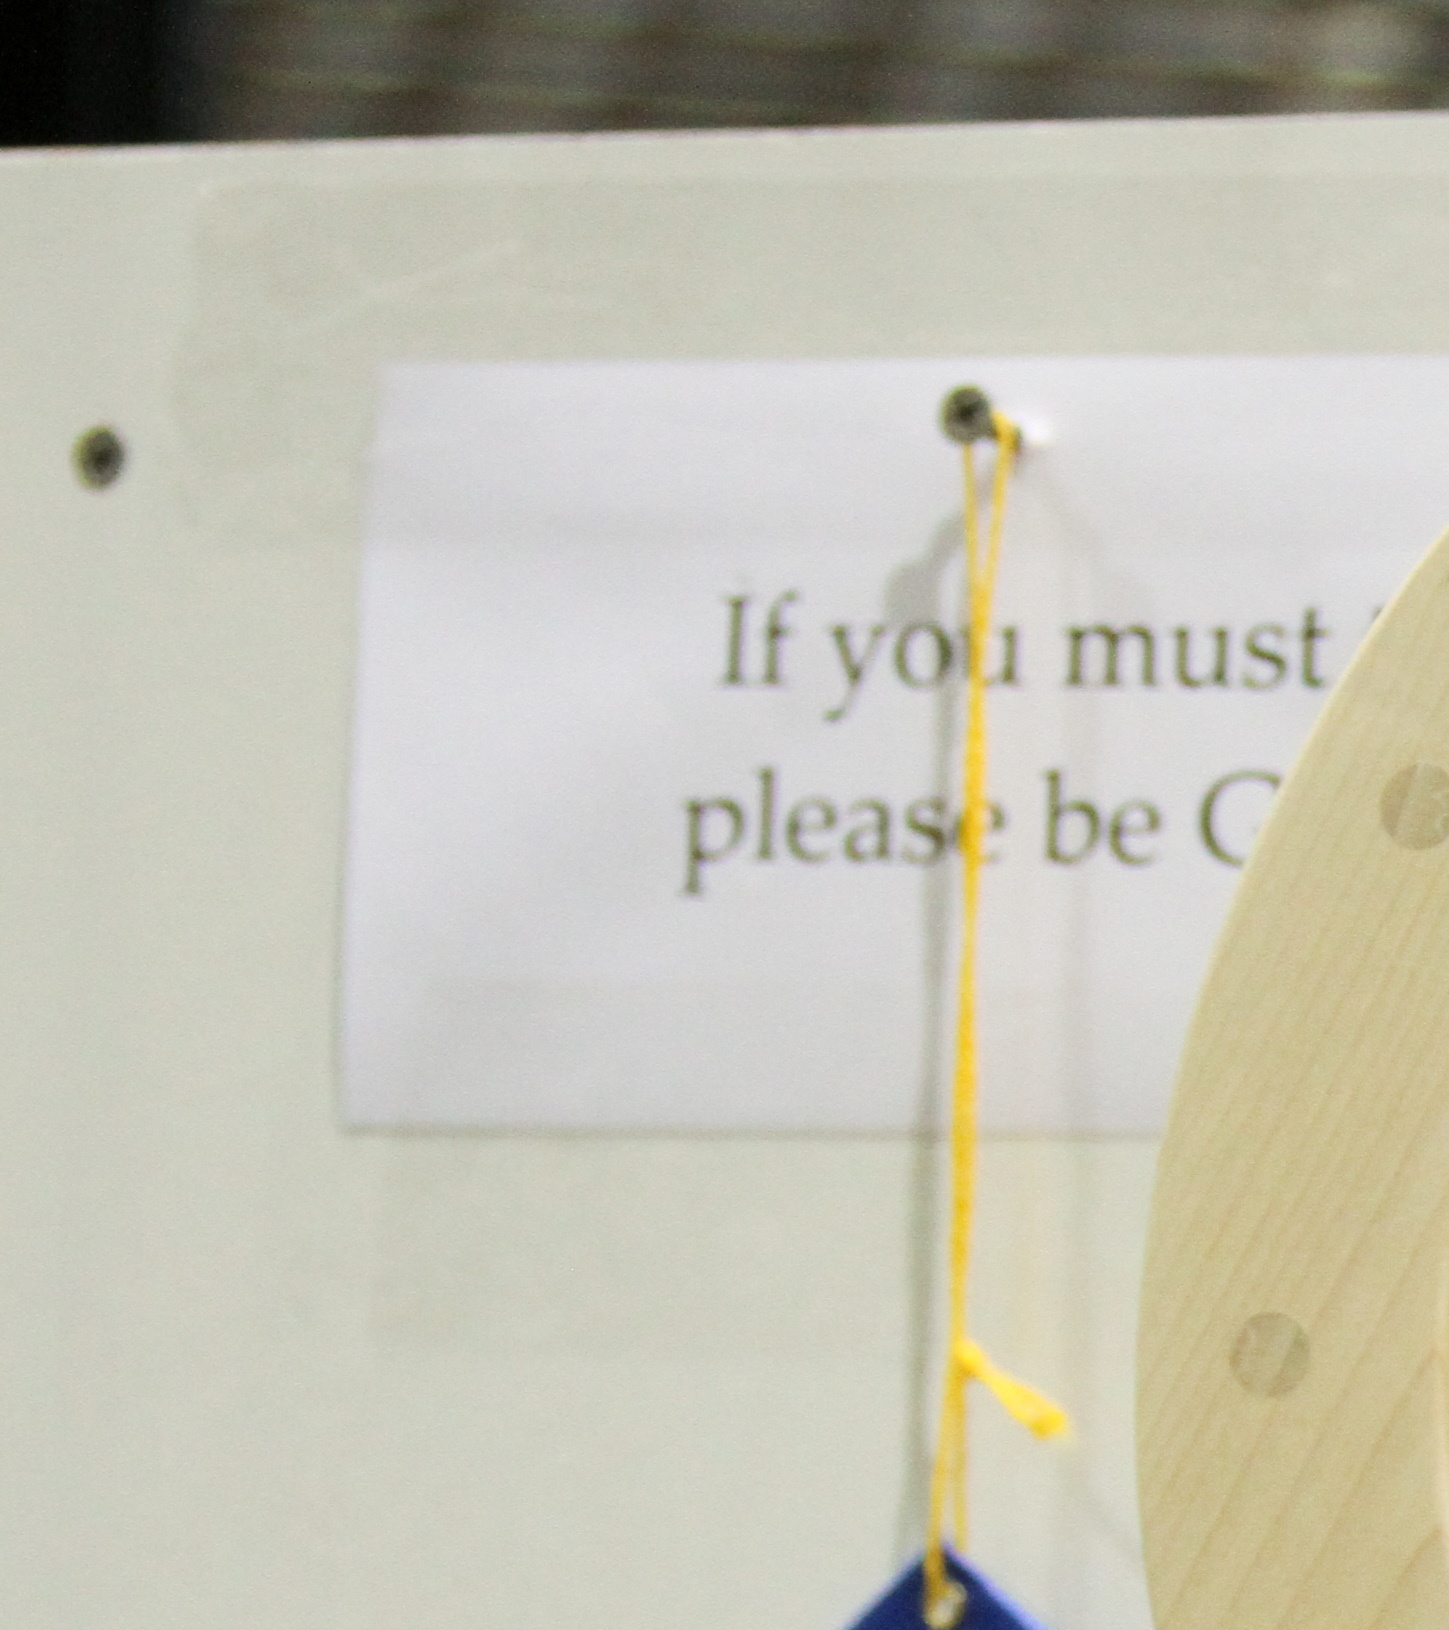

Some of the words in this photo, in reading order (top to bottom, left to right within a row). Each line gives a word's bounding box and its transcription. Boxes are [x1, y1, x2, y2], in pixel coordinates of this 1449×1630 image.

[720, 590, 798, 686] If
[823, 622, 1021, 721] you
[1066, 606, 1329, 689] must
[684, 765, 1006, 895] please
[1045, 767, 1161, 866] be
